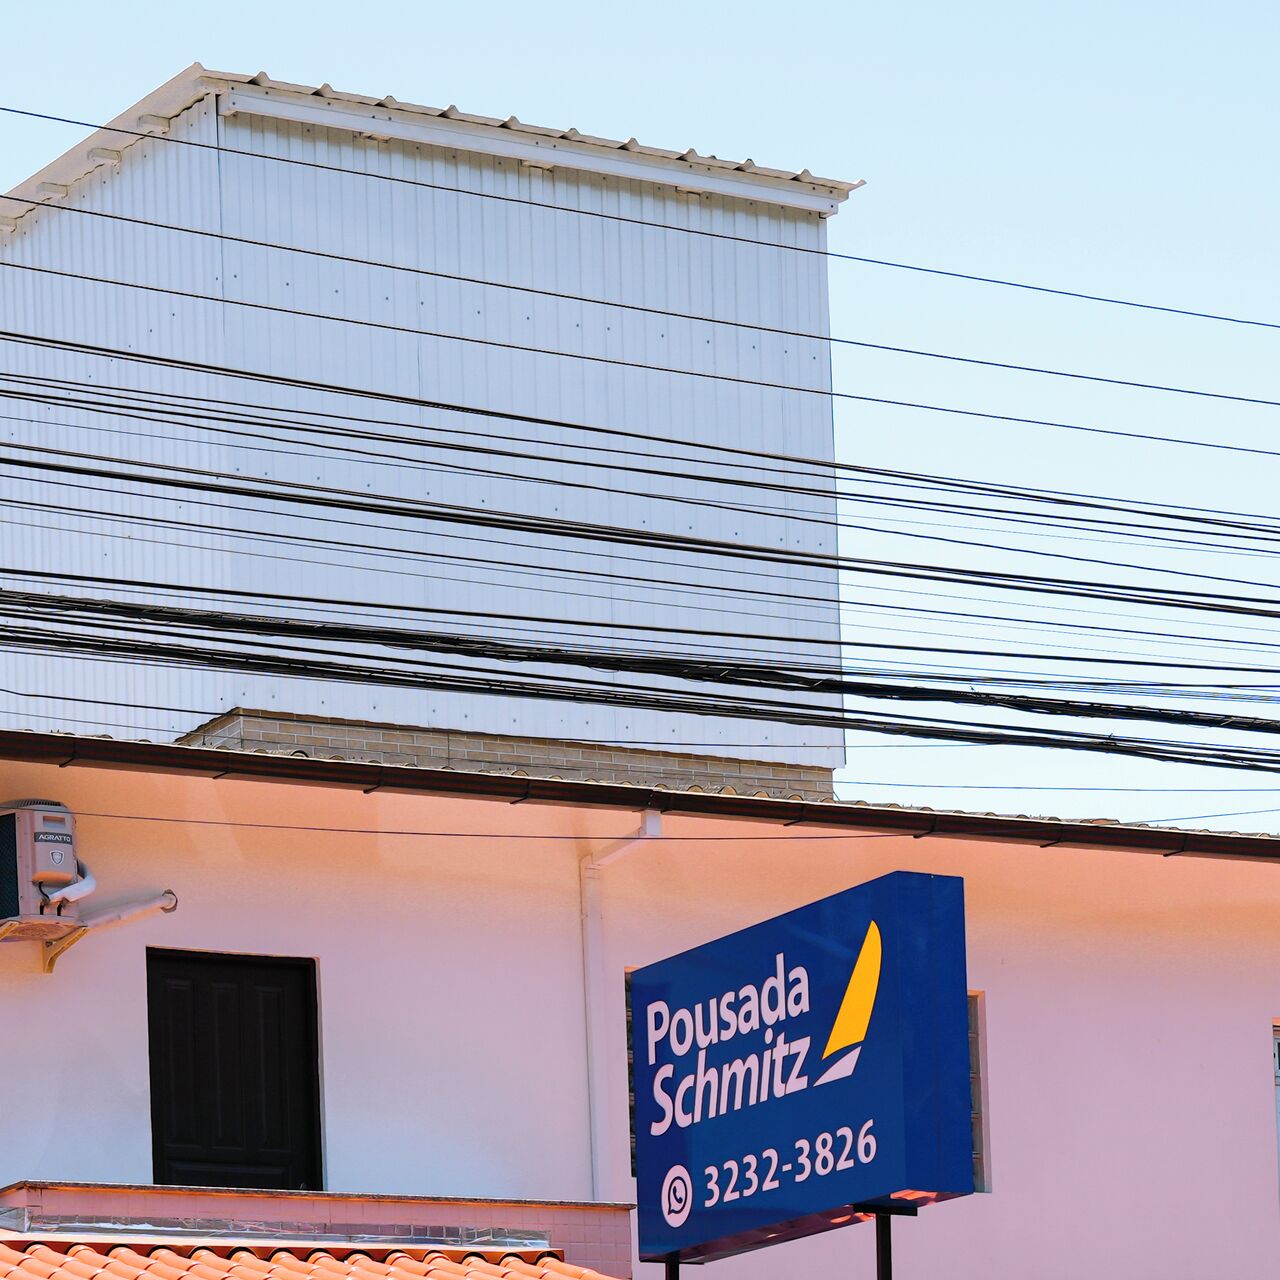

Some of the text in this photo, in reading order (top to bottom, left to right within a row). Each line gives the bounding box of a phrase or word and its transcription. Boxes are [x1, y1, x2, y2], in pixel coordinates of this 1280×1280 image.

[38, 834, 71, 842] AGRATTO
[646, 952, 810, 1066] Pousada
[649, 1027, 811, 1137] Schmitz
[703, 1118, 877, 1208] 3232-3826
